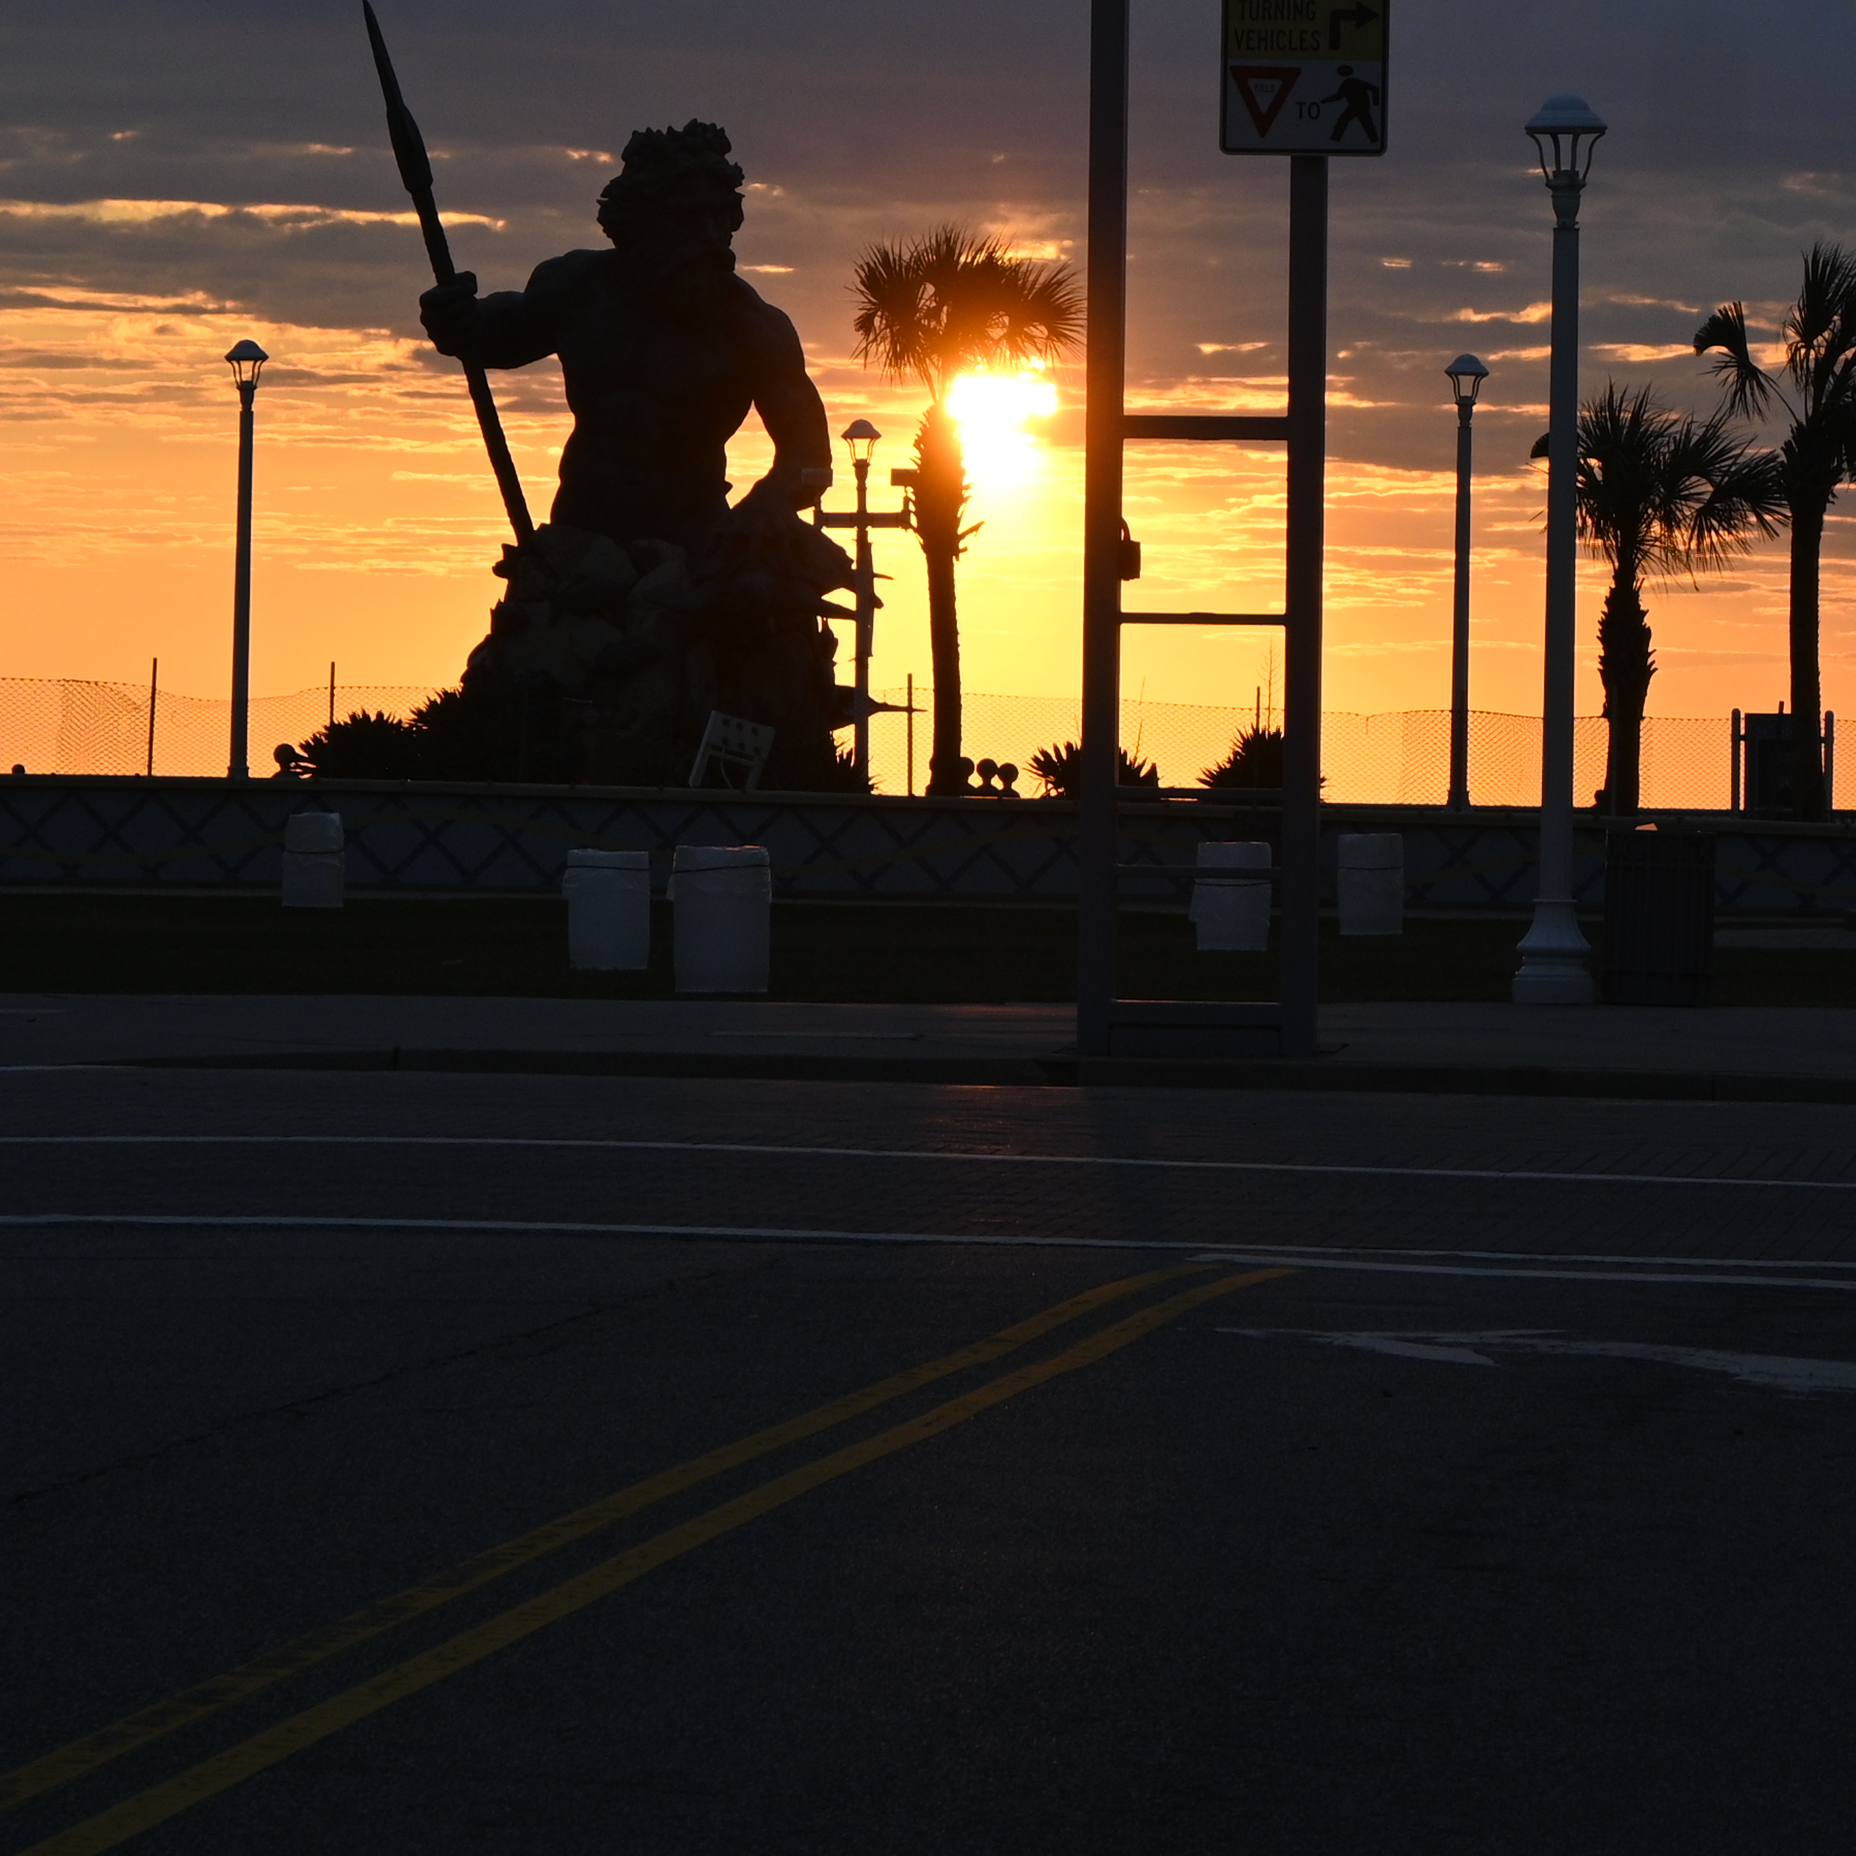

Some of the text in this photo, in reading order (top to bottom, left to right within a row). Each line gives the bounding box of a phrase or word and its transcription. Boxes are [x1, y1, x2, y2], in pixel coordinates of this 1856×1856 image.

[1234, 29, 1321, 51] VEHICLES
[1253, 83, 1275, 93] YIELD
[1295, 100, 1321, 120] TO
